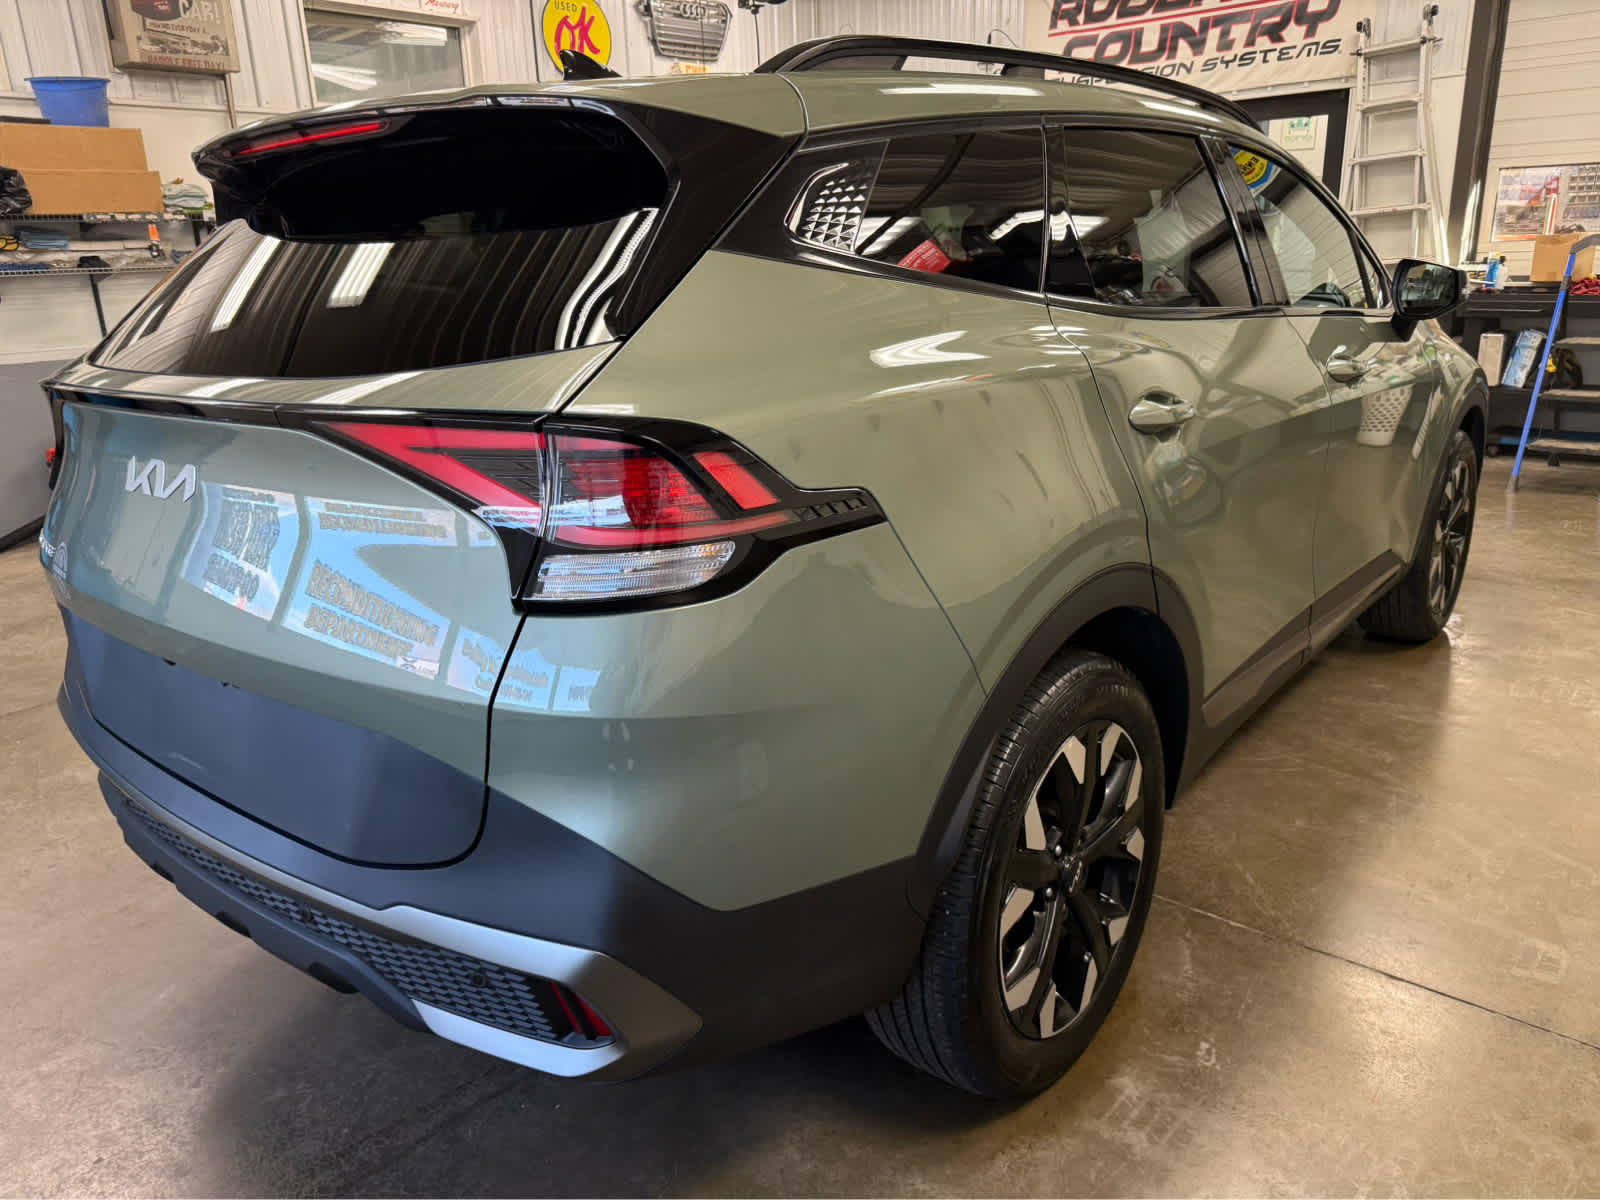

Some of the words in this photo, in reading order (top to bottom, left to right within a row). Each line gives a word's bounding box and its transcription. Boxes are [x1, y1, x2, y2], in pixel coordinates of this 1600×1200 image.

[555, 1, 578, 13] USED
[555, 6, 601, 54] OK
[1063, 0, 1342, 65] COUNTRY
[1201, 38, 1342, 72] SYSTEMS
[125, 456, 196, 503] KIA
[305, 558, 441, 648] RECONDITIONING
[304, 602, 414, 663] DEPARTMENT
